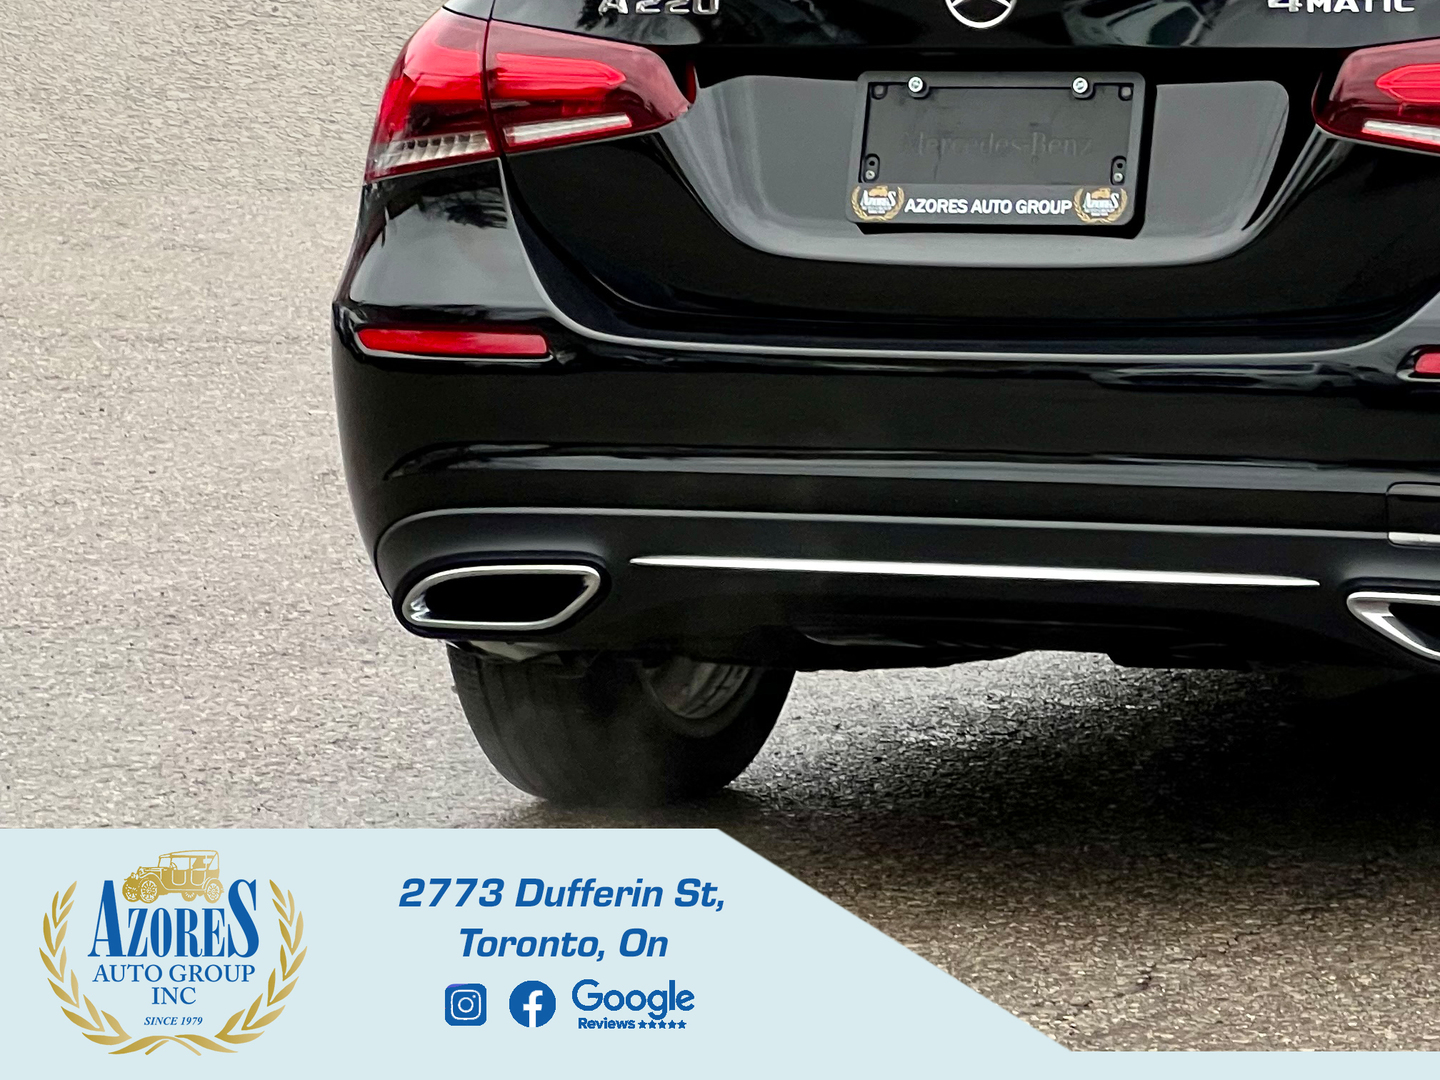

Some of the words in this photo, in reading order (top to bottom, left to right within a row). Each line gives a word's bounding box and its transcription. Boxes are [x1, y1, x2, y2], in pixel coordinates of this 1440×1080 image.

[904, 198, 968, 214] AZORES
[970, 199, 1012, 215] AUTO
[1015, 199, 1073, 215] GROUP
